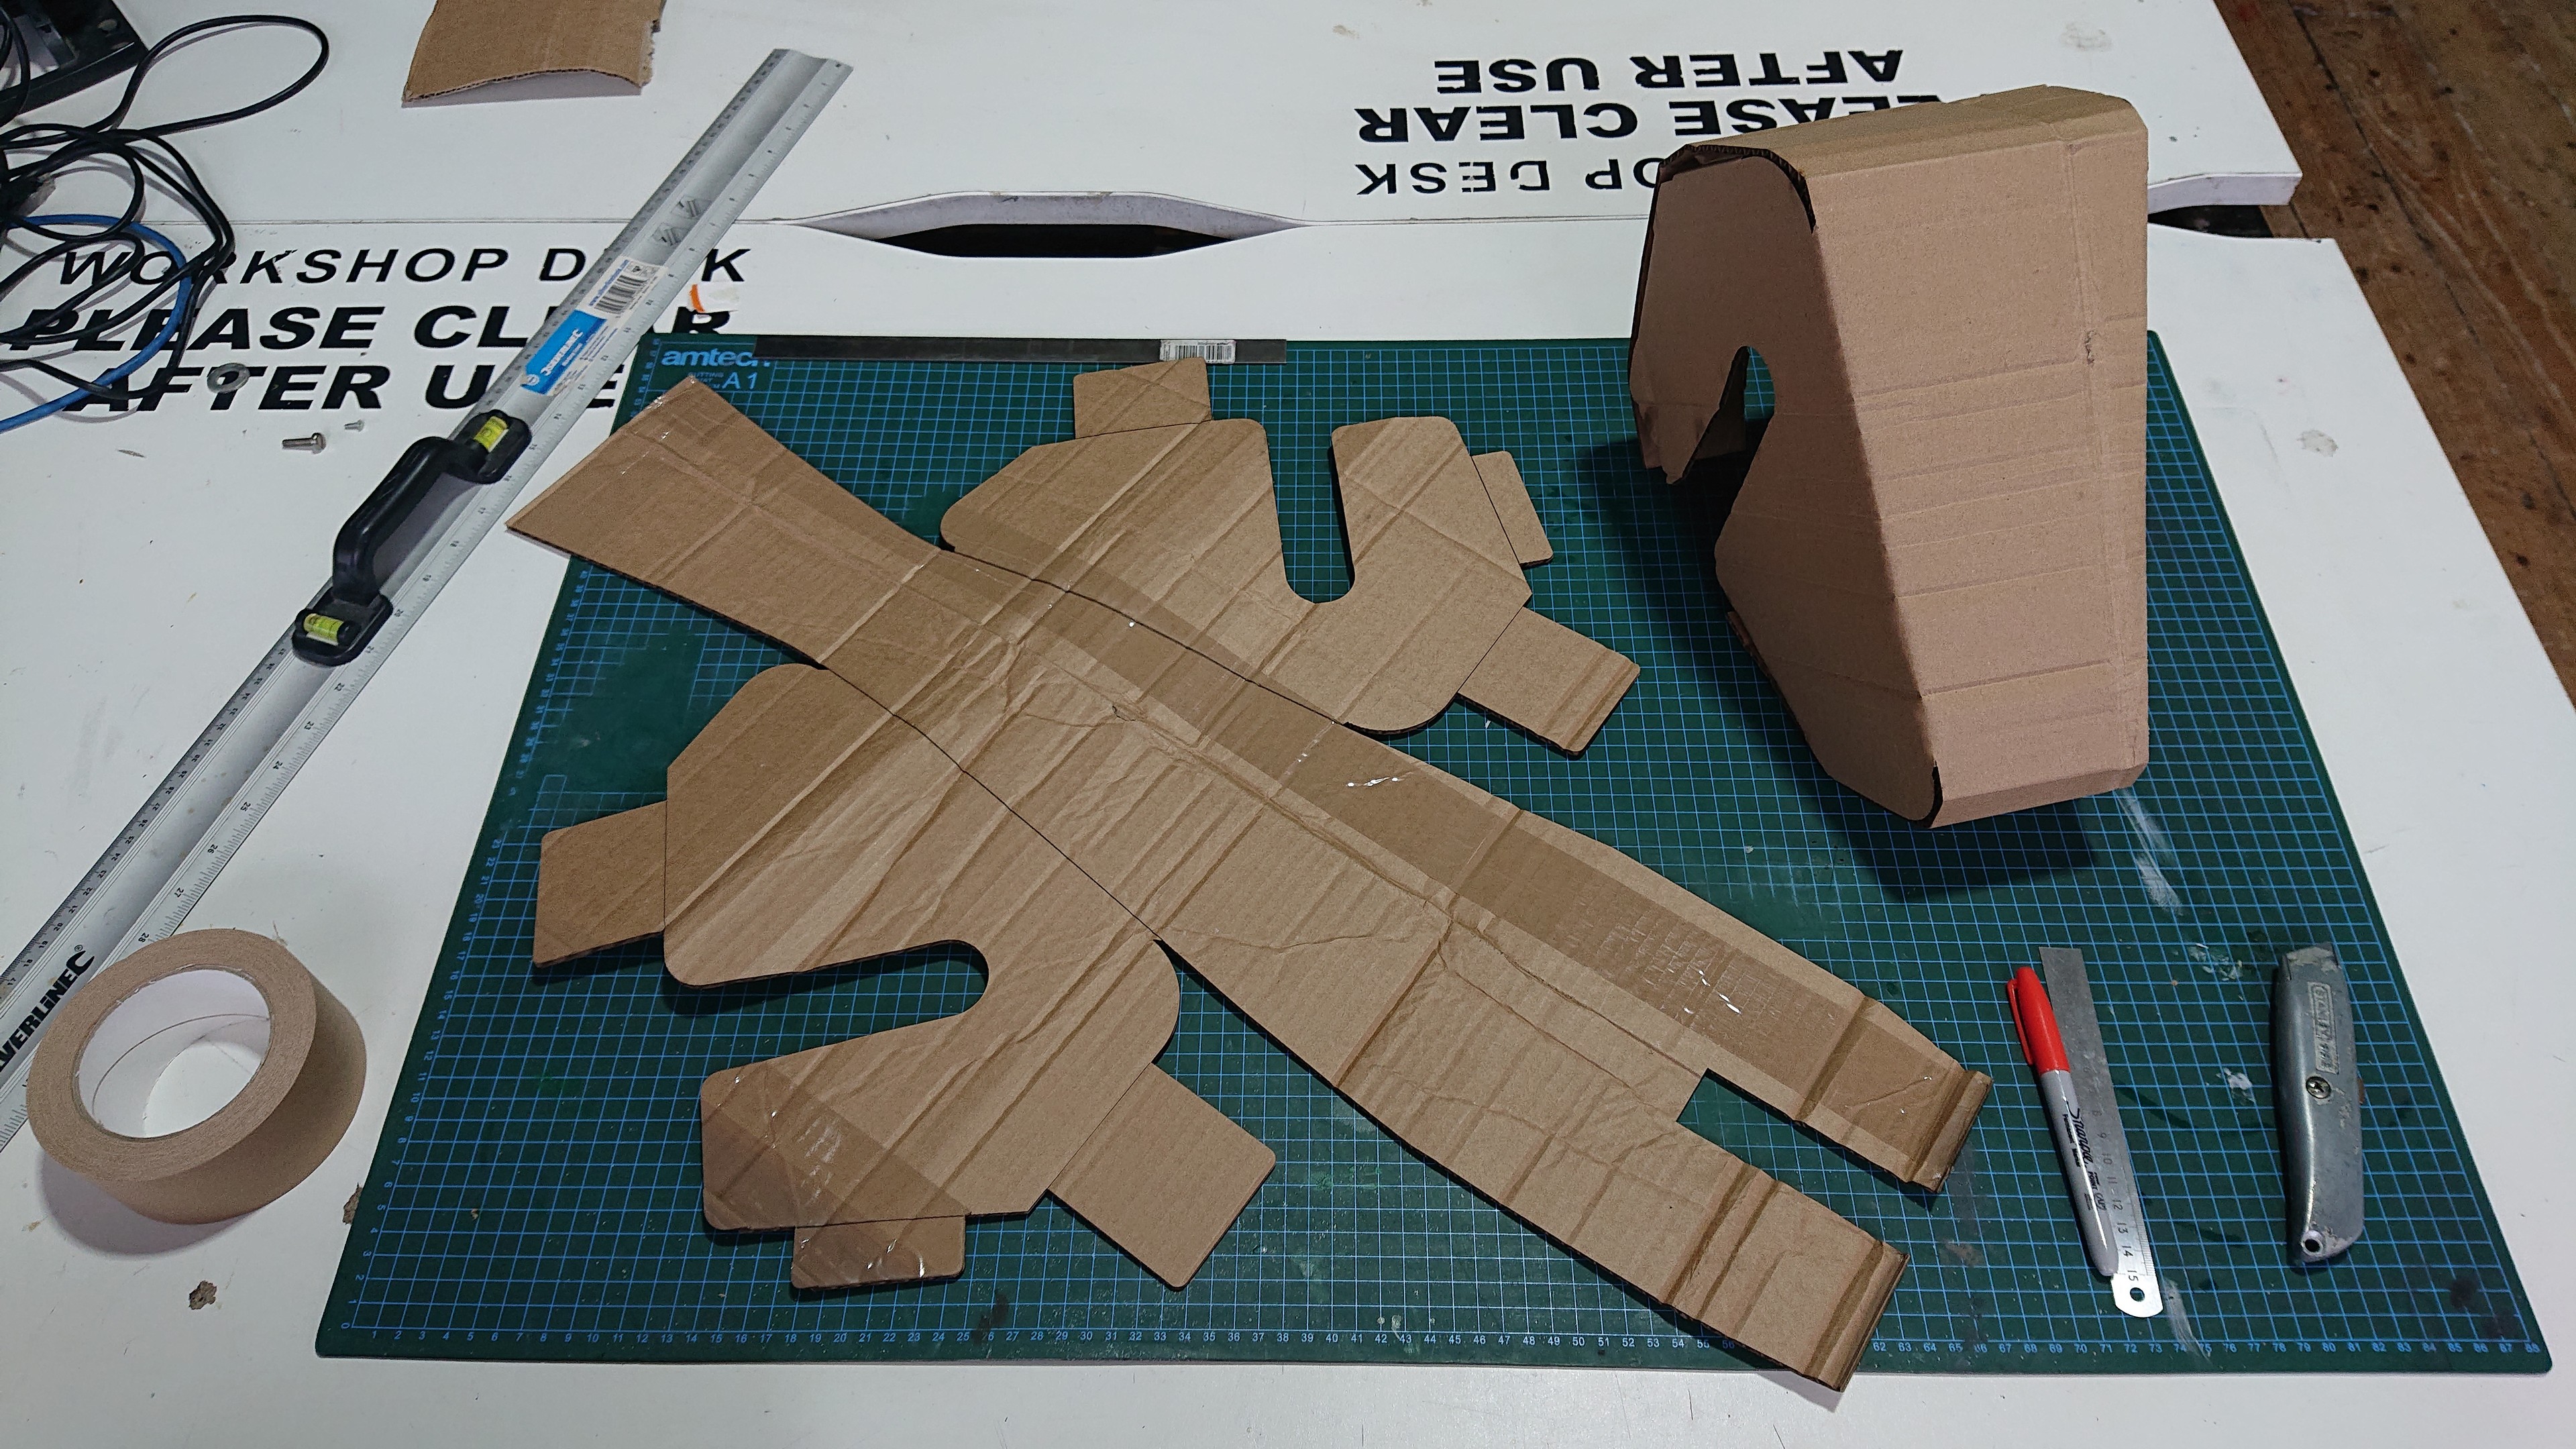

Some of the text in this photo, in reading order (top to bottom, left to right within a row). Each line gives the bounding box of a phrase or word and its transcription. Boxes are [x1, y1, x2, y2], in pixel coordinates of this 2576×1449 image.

[1434, 50, 1903, 95] AFTER USE
[1354, 102, 1638, 143] CLEAR
[1355, 158, 1550, 195] DESK
[539, 248, 751, 282] DK
[9, 306, 386, 351] PLEASE
[413, 305, 731, 348] CLR
[62, 365, 390, 412] AFTER
[333, 681, 345, 694] 22
[303, 719, 315, 732] 23
[271, 759, 283, 771] 24
[239, 800, 252, 812] 25
[207, 843, 218, 855] 26
[172, 886, 184, 898] 27
[5, 834, 136, 988] 17 18 19 20 21 22 23 24 25
[138, 930, 150, 943] 28
[2100, 1152, 2112, 1165] 10
[2106, 1176, 2118, 1185] 11
[2112, 1199, 2123, 1212] 12
[2116, 1222, 2129, 1234] 13
[2121, 1245, 2134, 1258] 14
[2127, 1269, 2139, 1282] 15
[372, 1330, 377, 1338] 1
[394, 1330, 402, 1339] 2
[418, 1330, 426, 1340] 3
[442, 1331, 449, 1340] 4
[466, 1331, 474, 1340] 5
[491, 1332, 499, 1341] 6
[516, 1332, 524, 1341] 7
[539, 1332, 547, 1342] 8
[564, 1332, 572, 1342] 9
[587, 1332, 600, 1342] 10
[612, 1332, 624, 1342] 11
[636, 1332, 649, 1342] 12
[661, 1333, 674, 1342] 13
[686, 1334, 698, 1342] 14
[710, 1333, 723, 1343] 15
[735, 1334, 748, 1343] 16
[760, 1333, 773, 1342] 17
[785, 1333, 797, 1342] 18
[810, 1333, 822, 1342] 19
[833, 1332, 847, 1342] 20
[858, 1332, 871, 1342] 21
[882, 1332, 896, 1342] 22
[907, 1331, 920, 1342] 23
[932, 1332, 945, 1341] 24
[956, 1331, 970, 1341] 25
[1006, 1330, 1020, 1341] 27
[1030, 1330, 1044, 1340] 28
[1055, 1330, 1069, 1341] 29
[1079, 1330, 1093, 1340] 30
[1105, 1330, 1117, 1340] 31
[1128, 1330, 1142, 1340] 32
[1154, 1331, 1167, 1340] 33
[1178, 1331, 1191, 1342] 34
[1203, 1330, 1216, 1341] 35
[1228, 1330, 1240, 1341] 36
[1252, 1332, 1265, 1342] 37
[1277, 1332, 1289, 1342] 38
[1301, 1332, 1314, 1342] 39
[1325, 1333, 1338, 1342] 40
[1350, 1332, 1362, 1343] 41
[1375, 1333, 1387, 1343] 42
[1394, 1332, 1412, 1343] 43
[1424, 1334, 1436, 1344] 44
[1448, 1334, 1461, 1344] 45
[1473, 1334, 1486, 1344] 46
[1498, 1334, 1511, 1344] 47
[1522, 1336, 1536, 1345] 48
[1547, 1336, 1560, 1345] 49
[1572, 1336, 1585, 1346] 50
[1598, 1336, 1609, 1346] 51
[1622, 1337, 1635, 1346] 52
[1647, 1338, 1660, 1347] 53
[1672, 1338, 1685, 1348] 54
[1872, 1341, 1887, 1351] 62
[1898, 1342, 1912, 1352] 63
[1923, 1342, 1937, 1352] 64
[1948, 1342, 1964, 1352] 65
[1998, 1342, 2012, 1353] 67
[2023, 1343, 2038, 1352] 68
[2048, 1343, 2063, 1352] 69
[2074, 1342, 2088, 1352] 70
[2098, 1342, 2113, 1352] 71
[2123, 1342, 2138, 1352] 72
[2148, 1342, 2163, 1352] 73
[2222, 1342, 2237, 1352] 76
[2247, 1342, 2261, 1352] 77
[2271, 1341, 2287, 1352] 78
